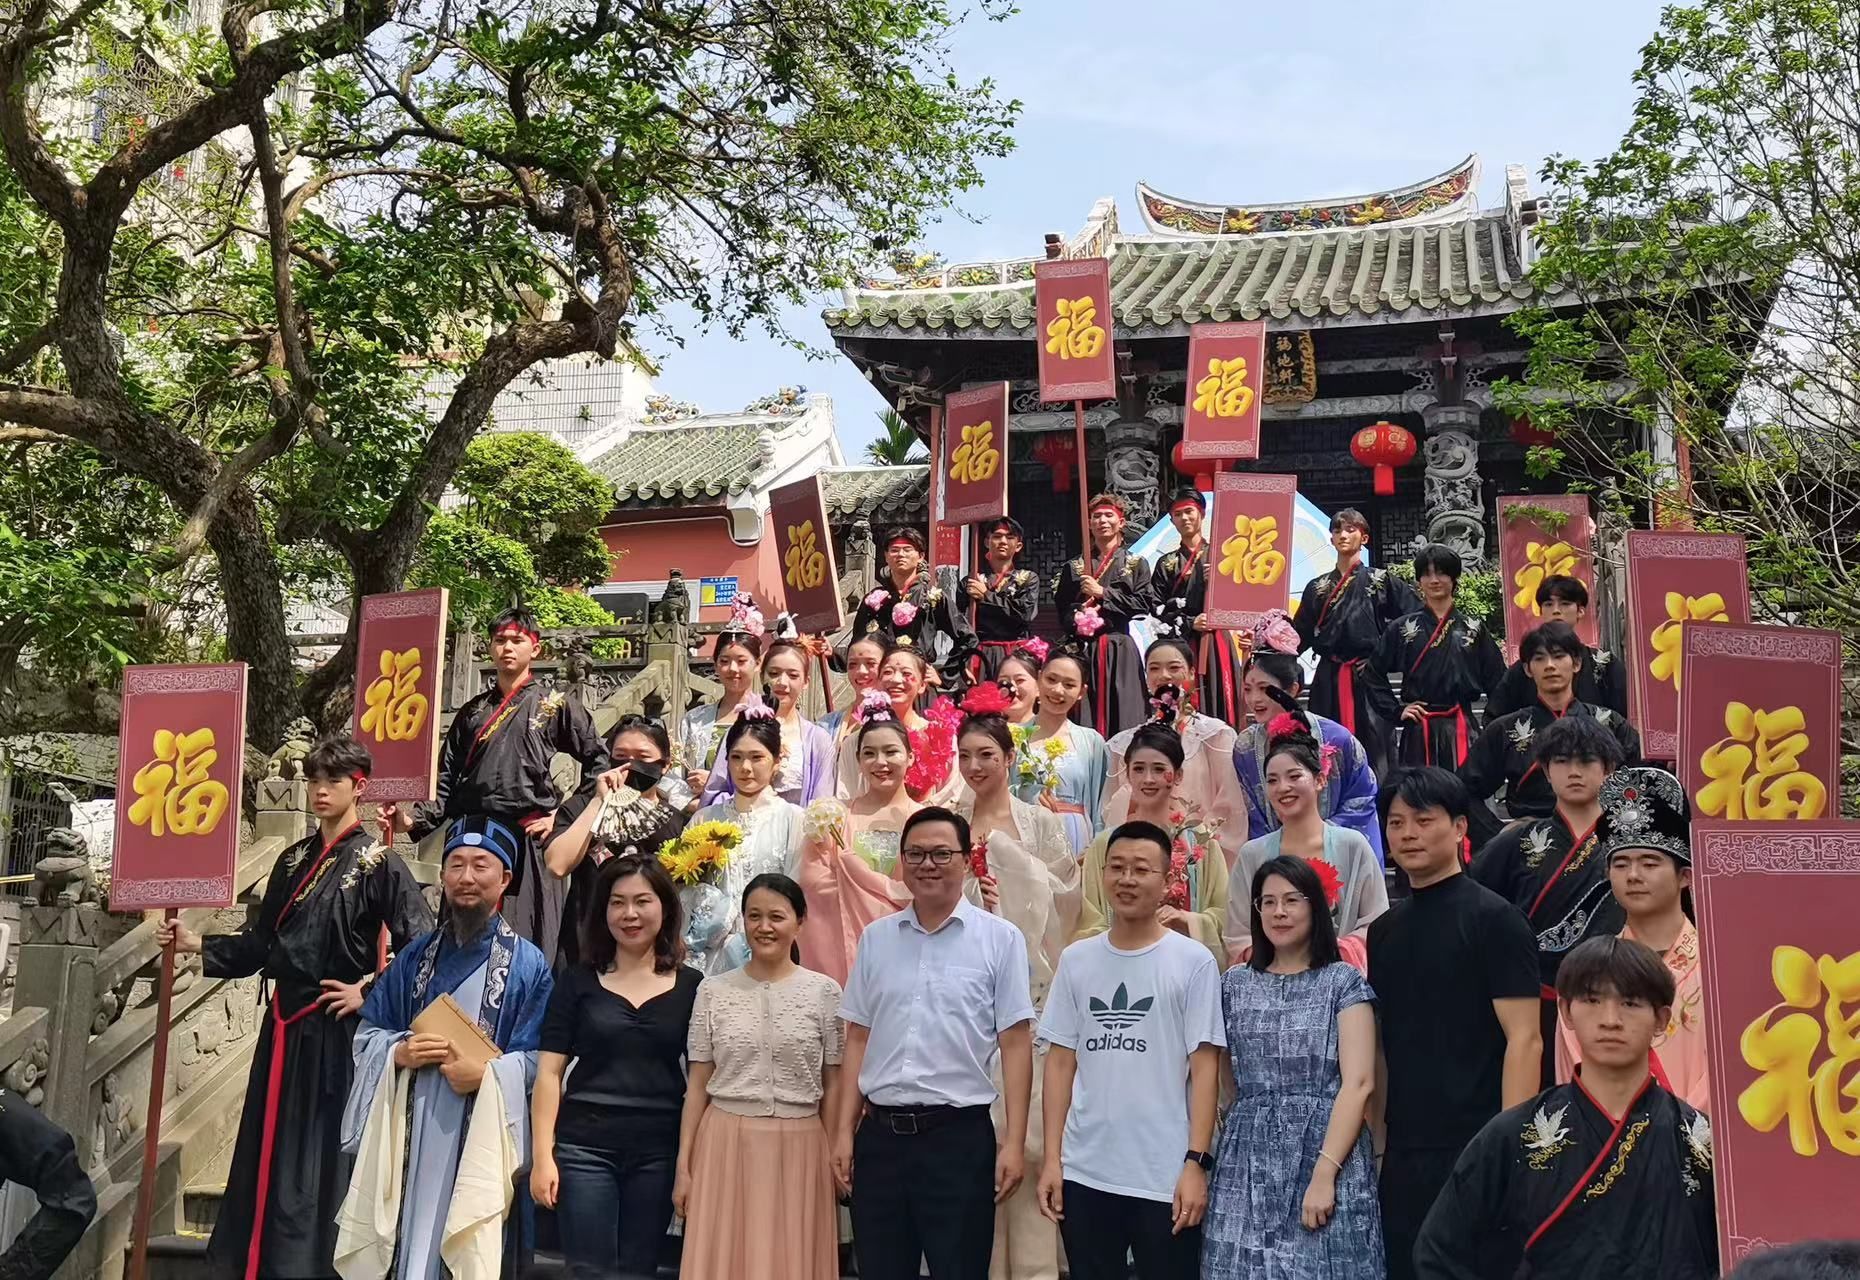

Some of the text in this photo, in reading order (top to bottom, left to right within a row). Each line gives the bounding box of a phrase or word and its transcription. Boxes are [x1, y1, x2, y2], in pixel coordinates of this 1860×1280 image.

[1046, 297, 1106, 360] 福
[1193, 357, 1254, 418] 福
[950, 421, 1000, 484] 福
[785, 520, 826, 591] 福
[1218, 515, 1286, 586] 福
[360, 647, 429, 742] 福
[127, 727, 230, 837] 福
[1696, 701, 1827, 820] 福
[1086, 1033, 1147, 1052] adidas
[1738, 945, 1860, 1156] 福
